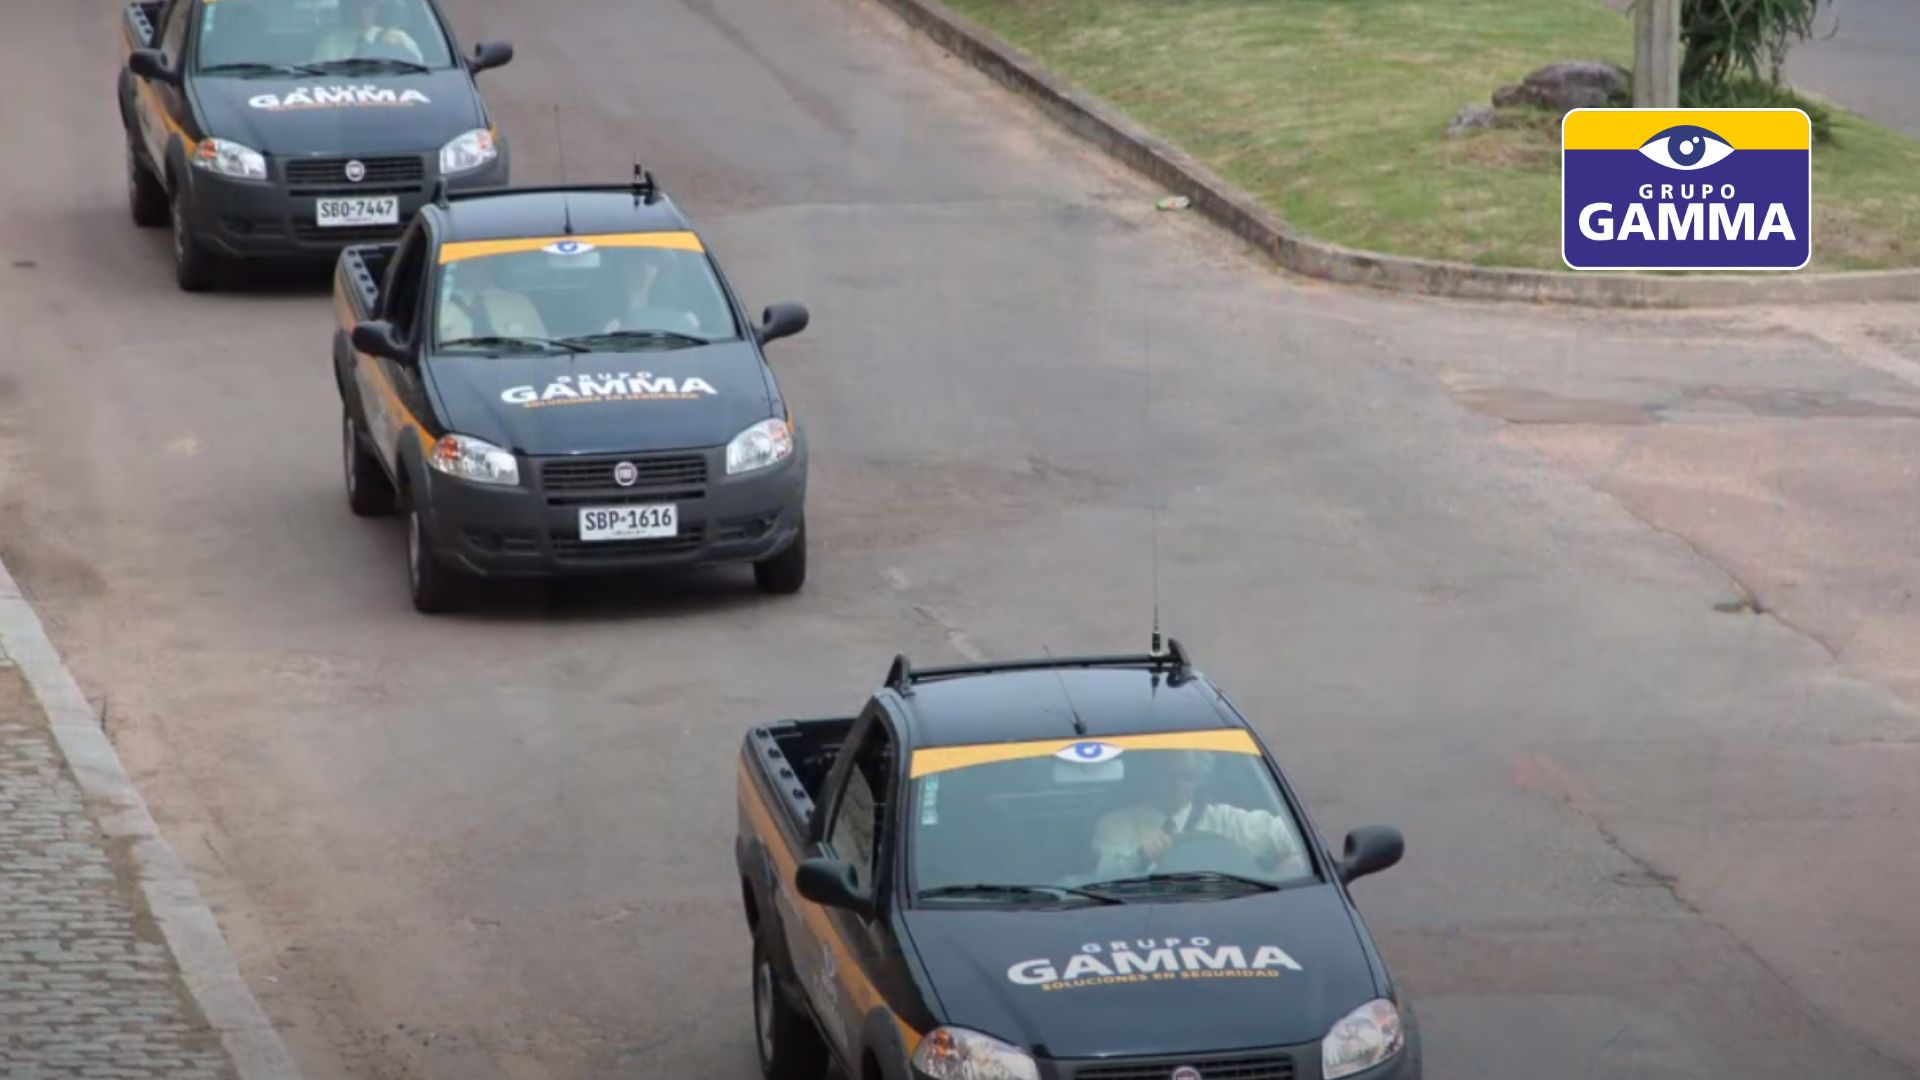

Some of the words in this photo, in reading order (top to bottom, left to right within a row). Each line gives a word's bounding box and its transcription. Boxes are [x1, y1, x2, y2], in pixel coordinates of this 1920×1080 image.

[501, 377, 717, 404] GAMMA
[1081, 936, 1211, 953] GRUPO
[1007, 945, 1302, 985] GAMMA
[1041, 973, 1148, 991] SOLUCIONES
[1152, 971, 1175, 979] EN
[1180, 969, 1280, 978] SEGURIDAD
